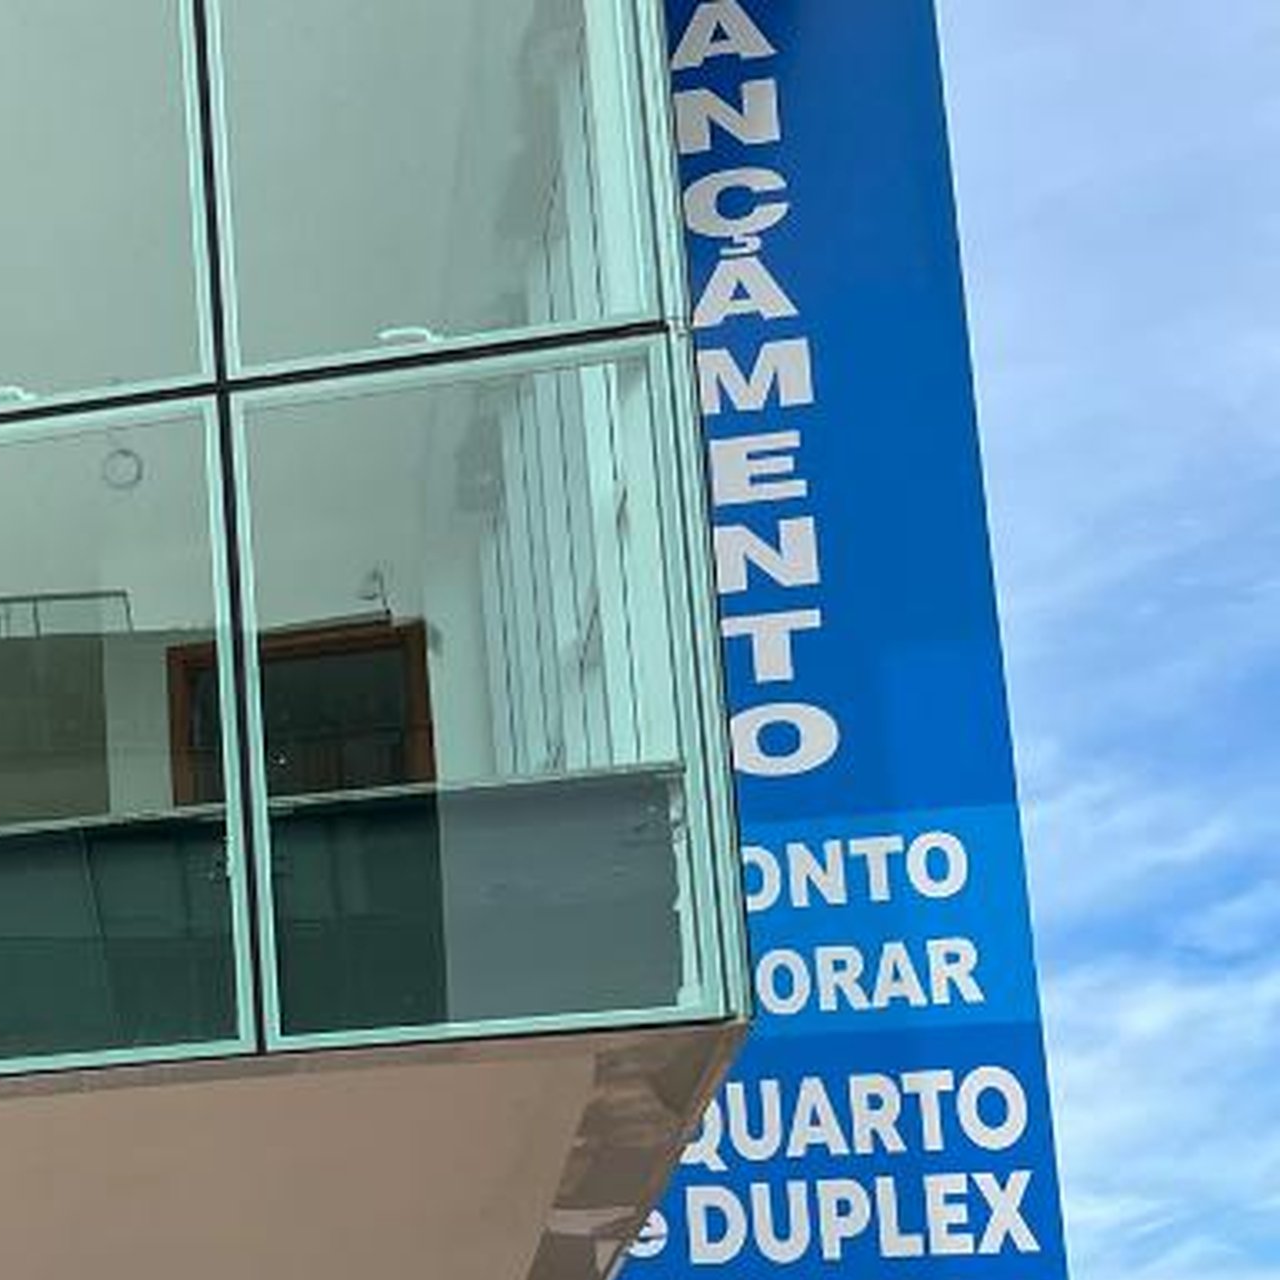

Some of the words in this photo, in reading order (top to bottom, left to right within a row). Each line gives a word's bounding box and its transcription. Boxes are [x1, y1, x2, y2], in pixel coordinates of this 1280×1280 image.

[670, 0, 840, 777] ANÇAMENTO
[740, 831, 968, 912] ONTO
[754, 937, 985, 1016] ORAR
[686, 1169, 1040, 1264] DUPLEX
